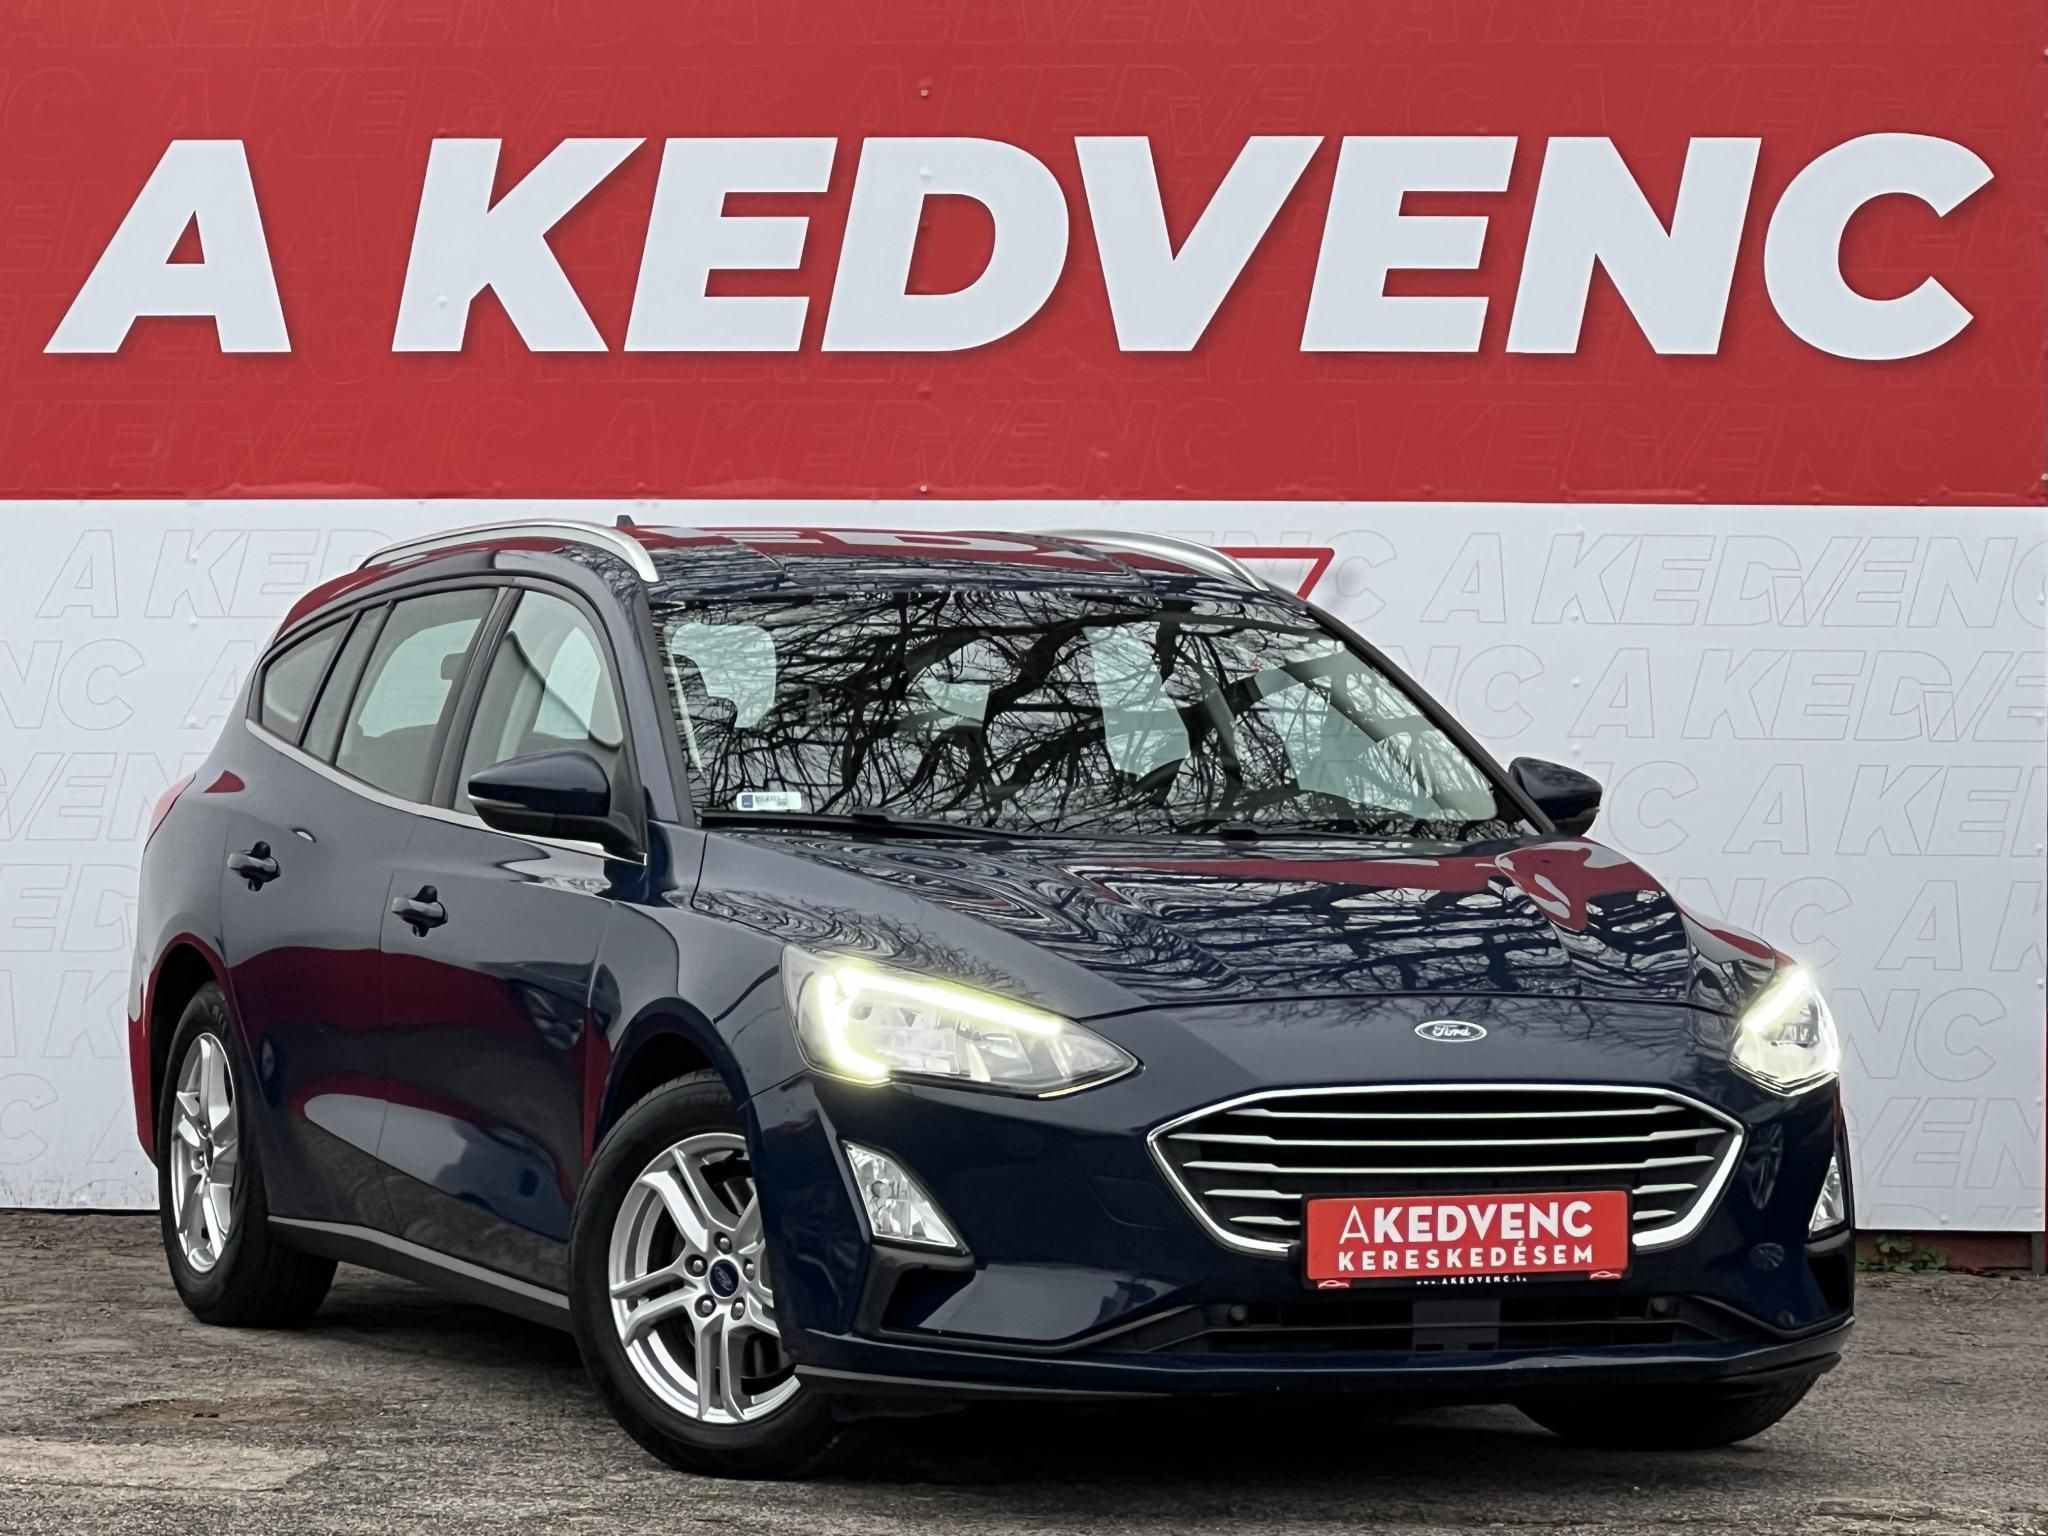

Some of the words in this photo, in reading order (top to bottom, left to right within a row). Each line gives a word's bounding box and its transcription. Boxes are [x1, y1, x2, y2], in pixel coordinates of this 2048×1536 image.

[44, 139, 292, 355] A
[391, 132, 1995, 362] KEDVENC
[1338, 1240, 1593, 1271] KERESKEDÉSEM
